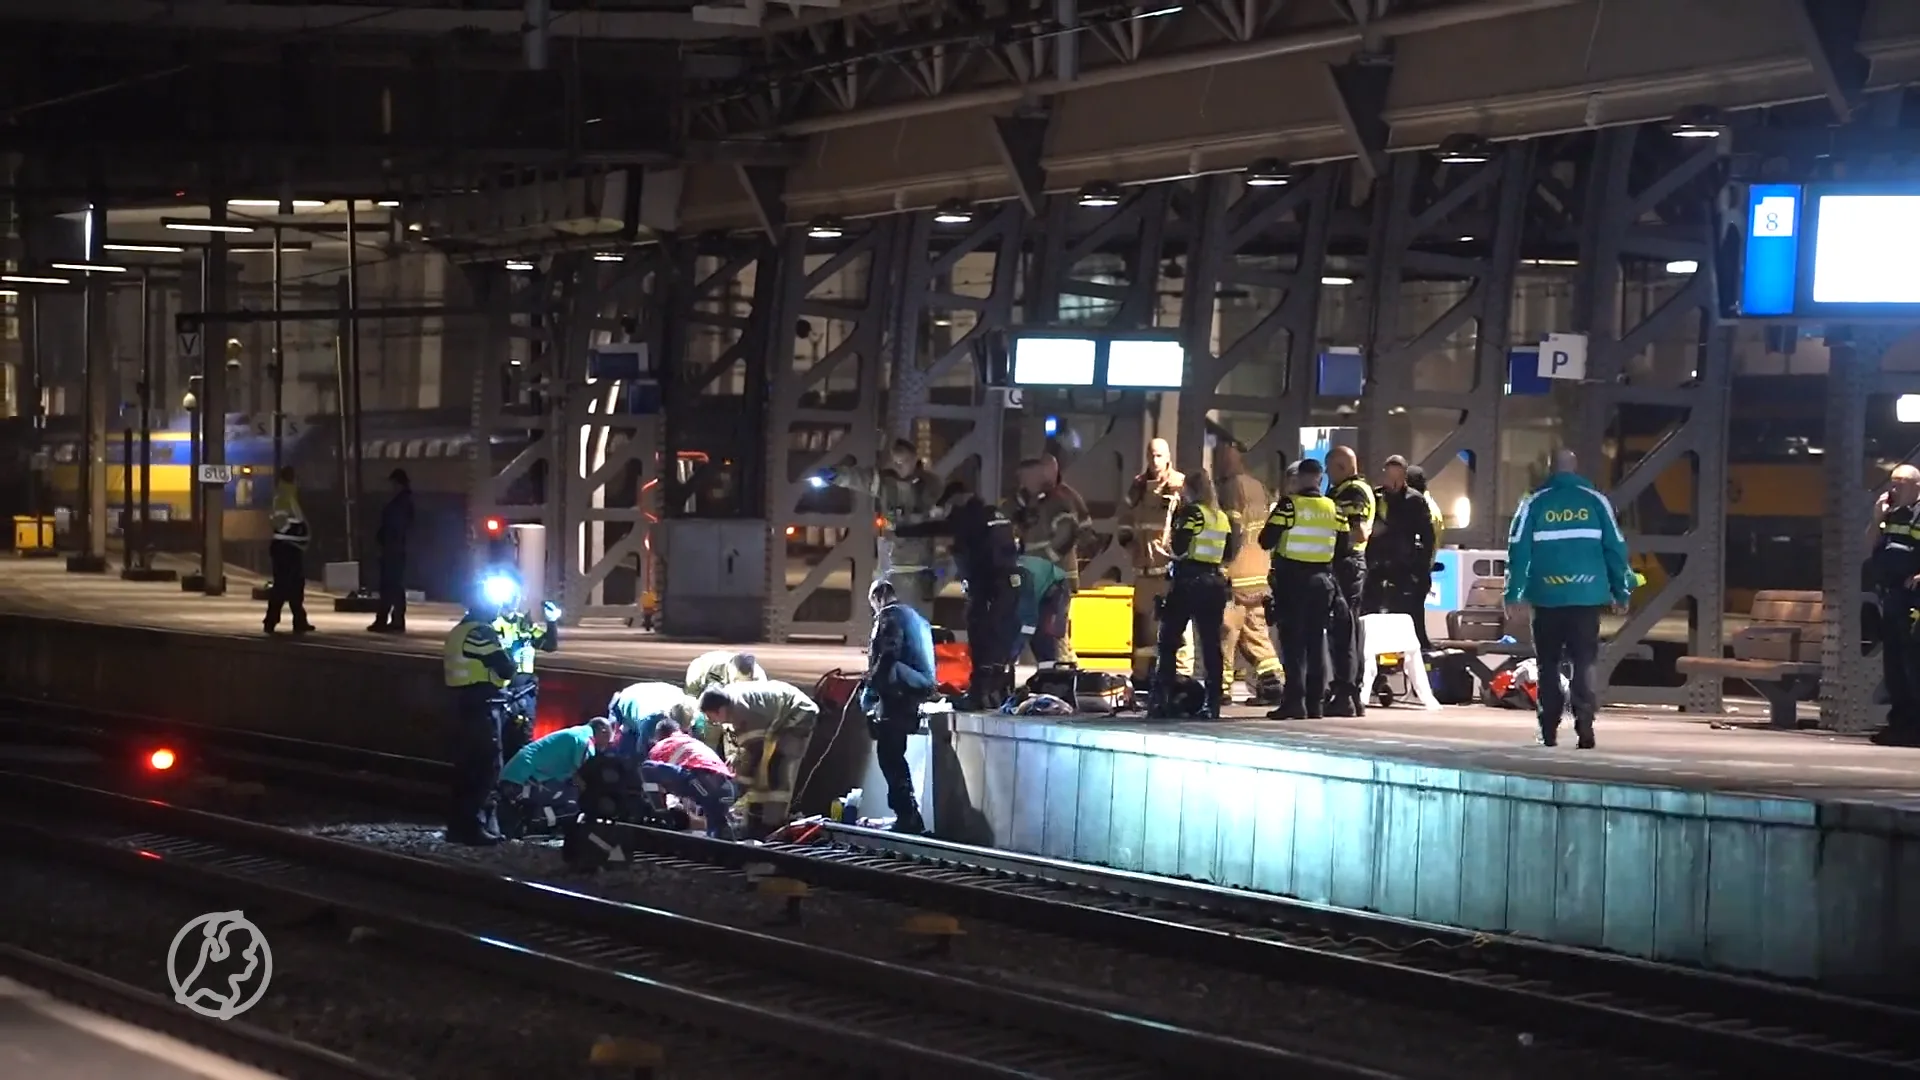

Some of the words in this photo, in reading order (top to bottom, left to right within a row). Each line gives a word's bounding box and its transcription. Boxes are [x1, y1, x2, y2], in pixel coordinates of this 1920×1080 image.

[1766, 212, 1778, 231] 8
[1552, 350, 1569, 375] P
[1545, 508, 1589, 522] OvD-G
